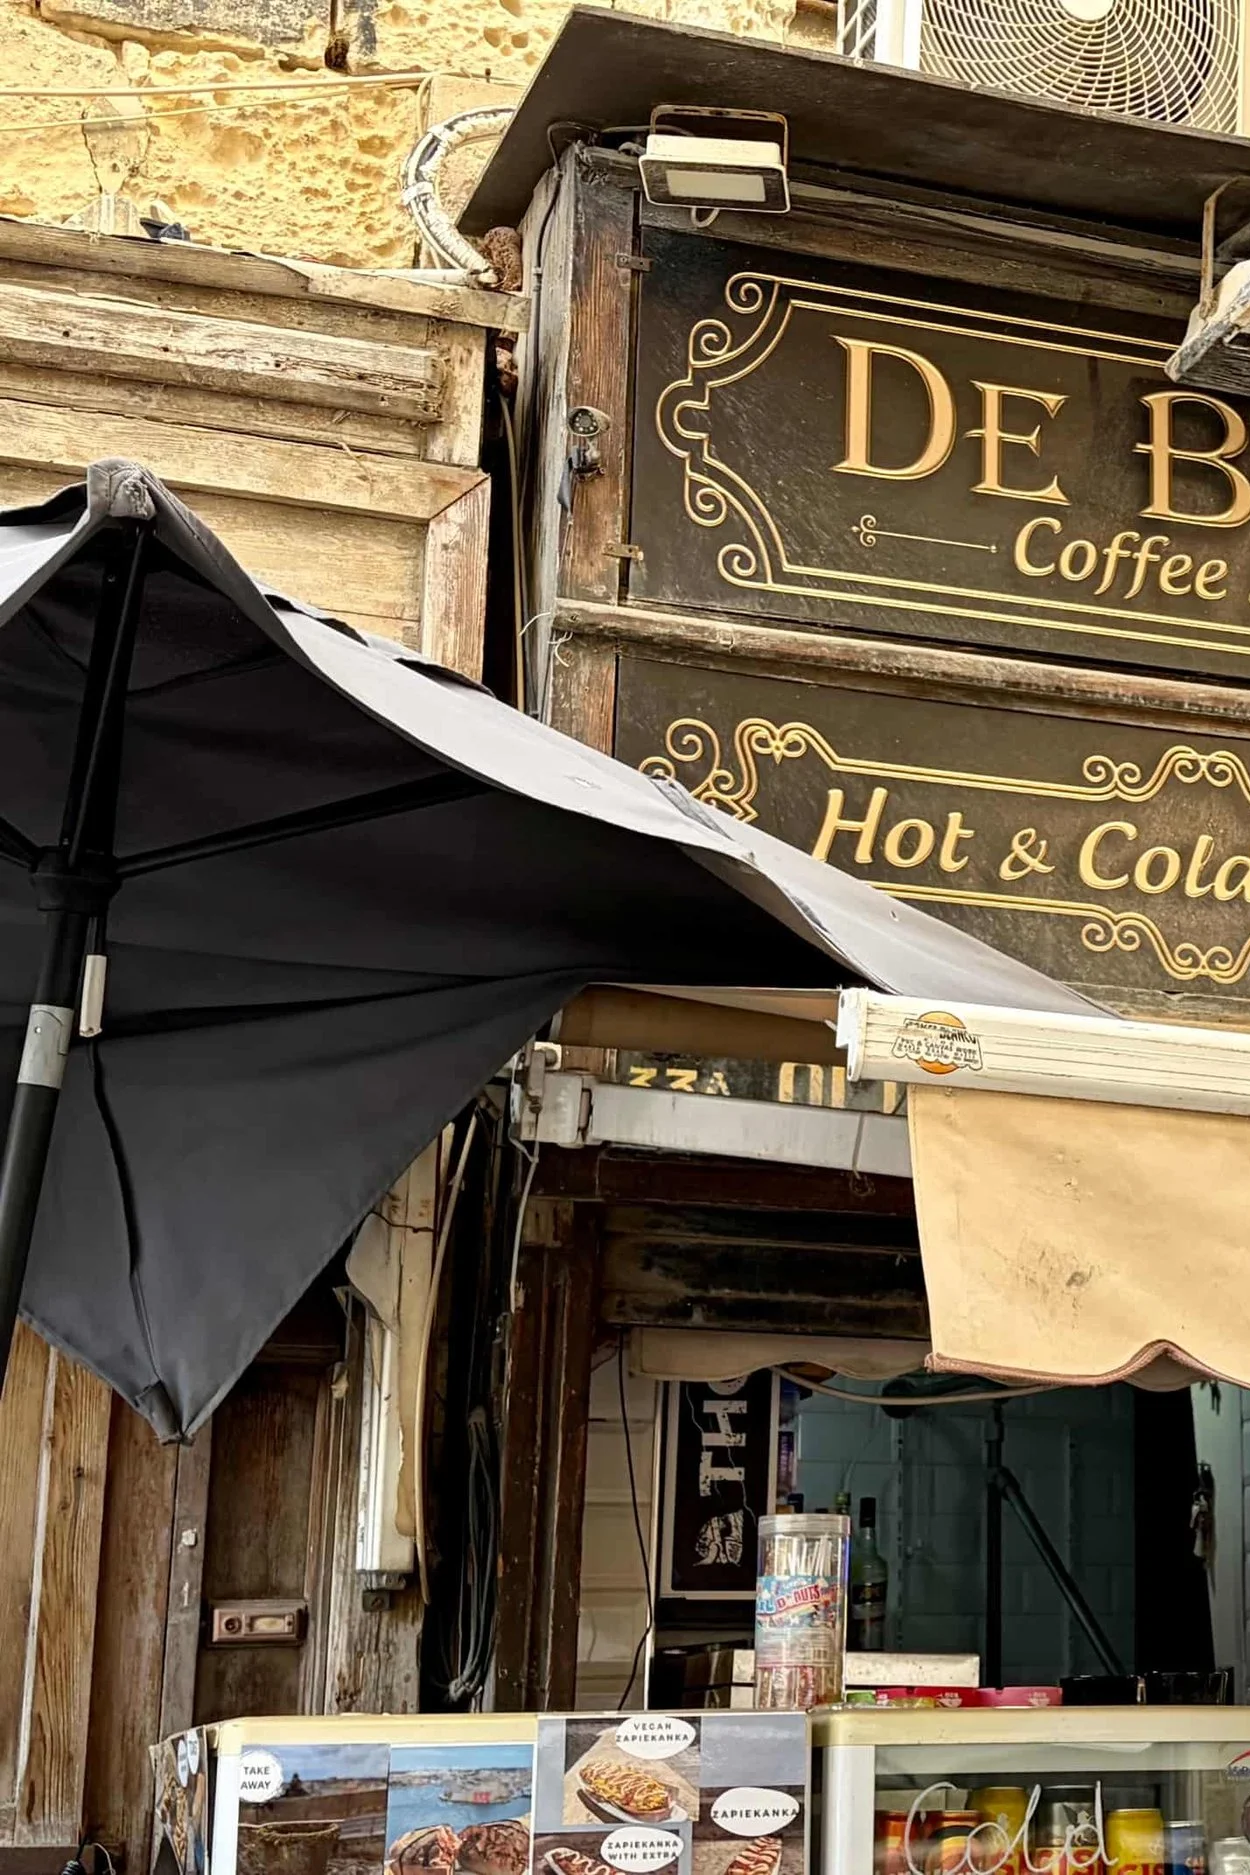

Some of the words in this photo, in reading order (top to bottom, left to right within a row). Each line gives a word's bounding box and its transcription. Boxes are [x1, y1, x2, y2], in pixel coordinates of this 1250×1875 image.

[831, 335, 1069, 507] DE
[1013, 516, 1228, 602] Coffee
[813, 787, 974, 873] Hot
[998, 827, 1056, 881] &
[633, 1722, 673, 1731] VEGAN
[615, 1733, 690, 1743] ZAPIEKANKA
[243, 1766, 270, 1775] TAKE
[240, 1780, 272, 1790] AWAY
[711, 1807, 799, 1819] ZAPIEKANKA
[904, 1780, 1119, 1875] Cold
[606, 1841, 680, 1850] ZAPIEKANKA
[607, 1851, 637, 1861] WITH
[641, 1851, 678, 1861] EXTRA
